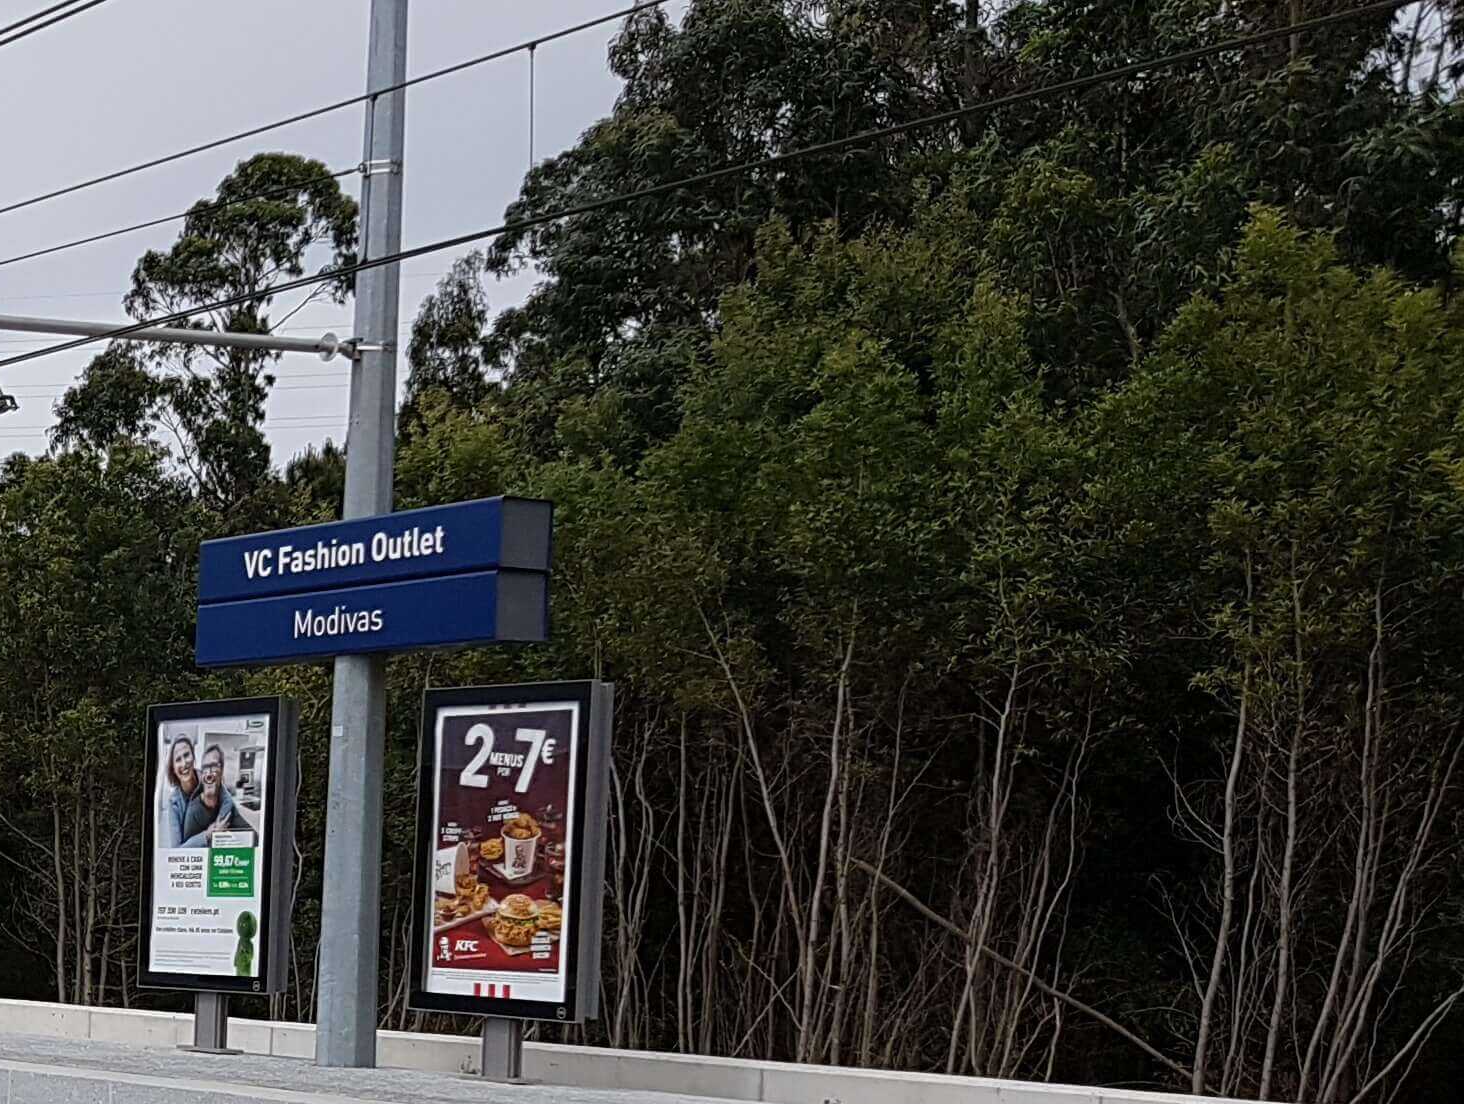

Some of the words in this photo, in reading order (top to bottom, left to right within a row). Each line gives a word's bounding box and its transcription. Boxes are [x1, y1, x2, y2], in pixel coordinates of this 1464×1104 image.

[244, 549, 273, 579] VC
[278, 538, 365, 575] Fashion
[371, 526, 444, 562] Outlet
[294, 605, 384, 639] Modivas
[459, 723, 495, 788] 2
[489, 751, 524, 768] MENUS
[454, 940, 479, 951] KFC
